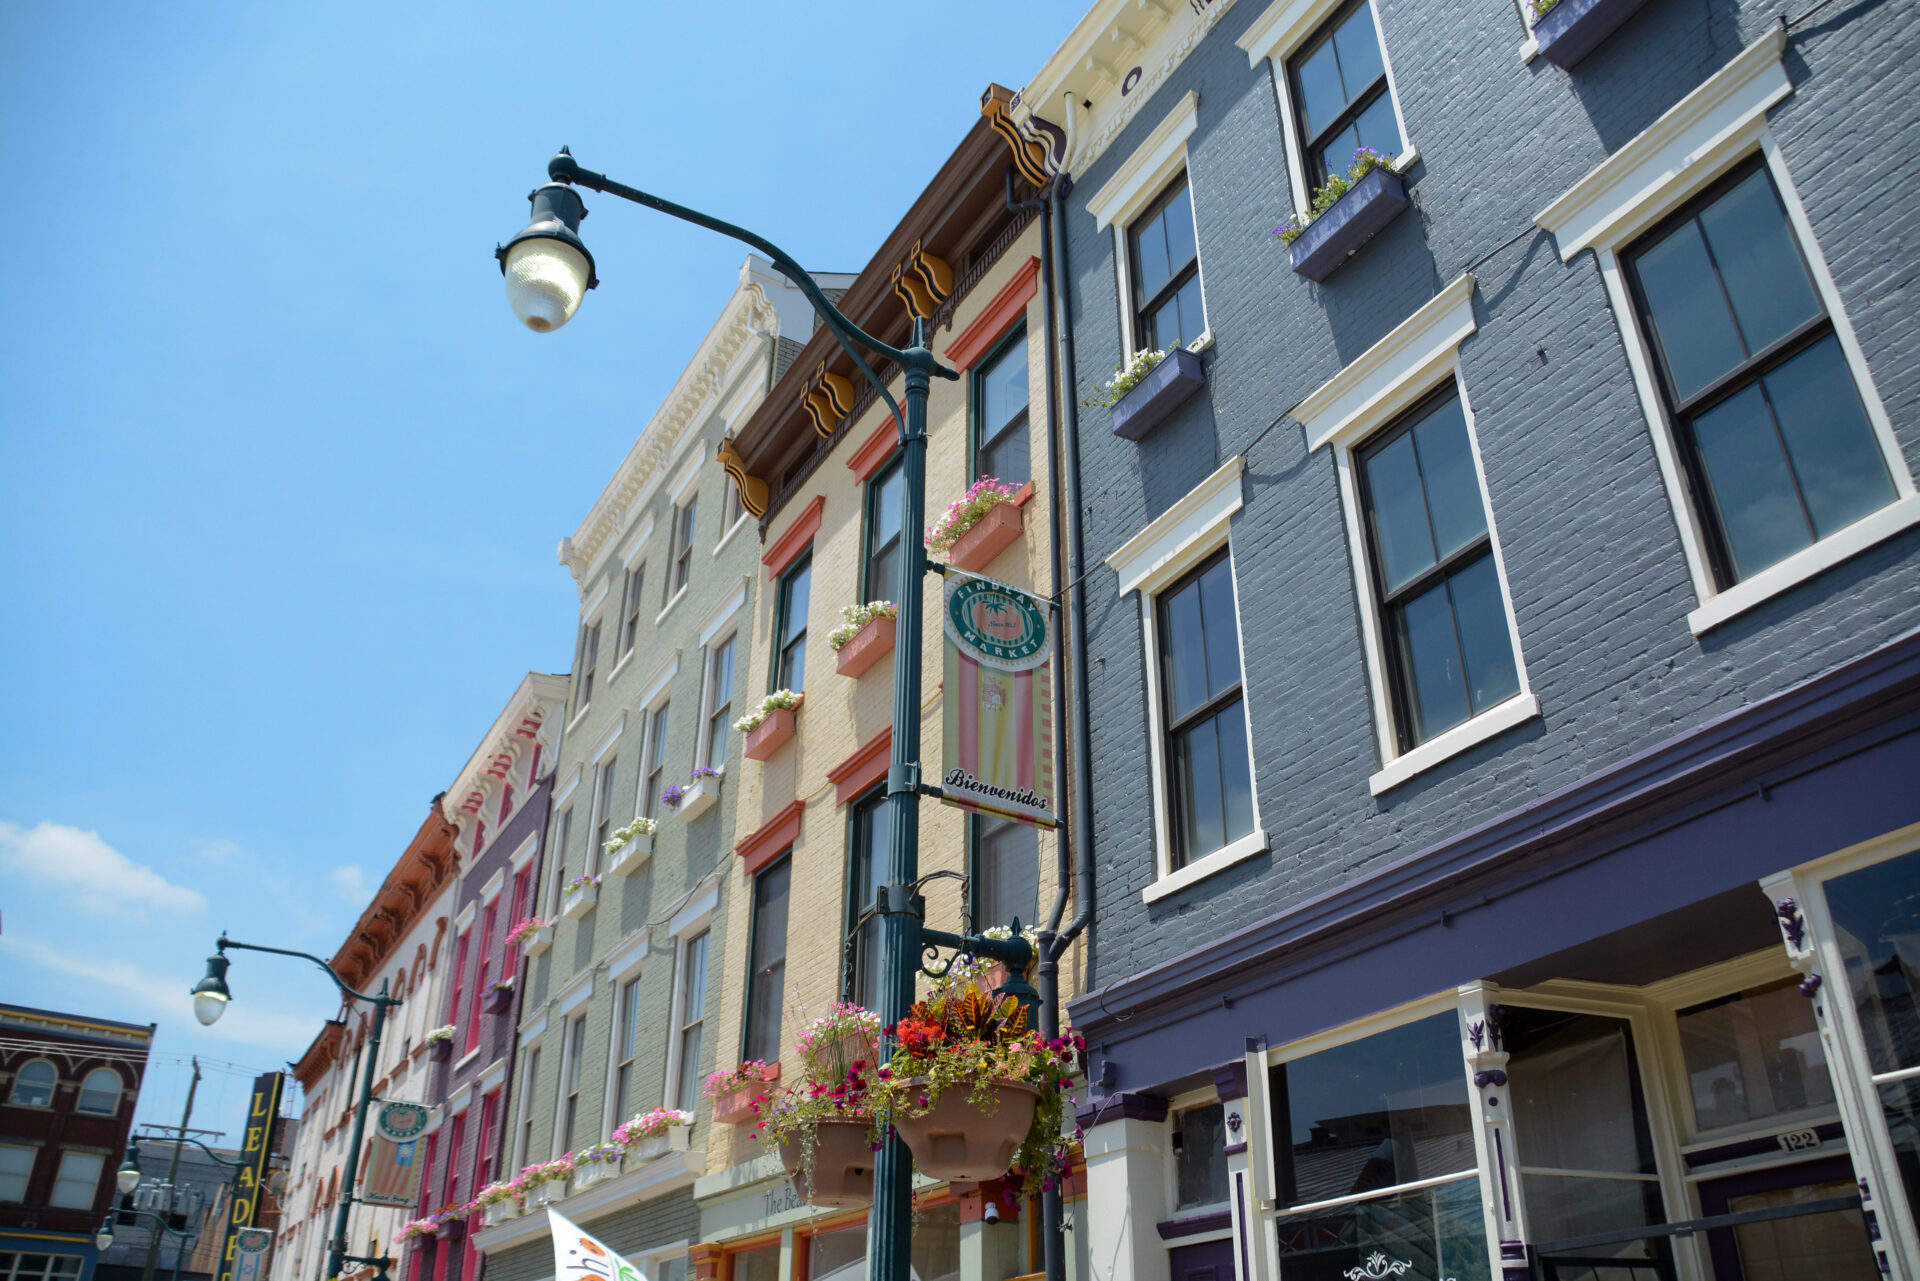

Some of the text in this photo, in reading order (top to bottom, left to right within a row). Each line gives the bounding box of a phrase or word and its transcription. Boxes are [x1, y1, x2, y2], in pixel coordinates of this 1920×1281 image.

[957, 581, 1036, 612] FINDLAY
[964, 631, 1037, 658] MARKET
[945, 768, 1048, 808] Bienvenidos
[1783, 1132, 1818, 1152] 122
[763, 1189, 782, 1216] The
